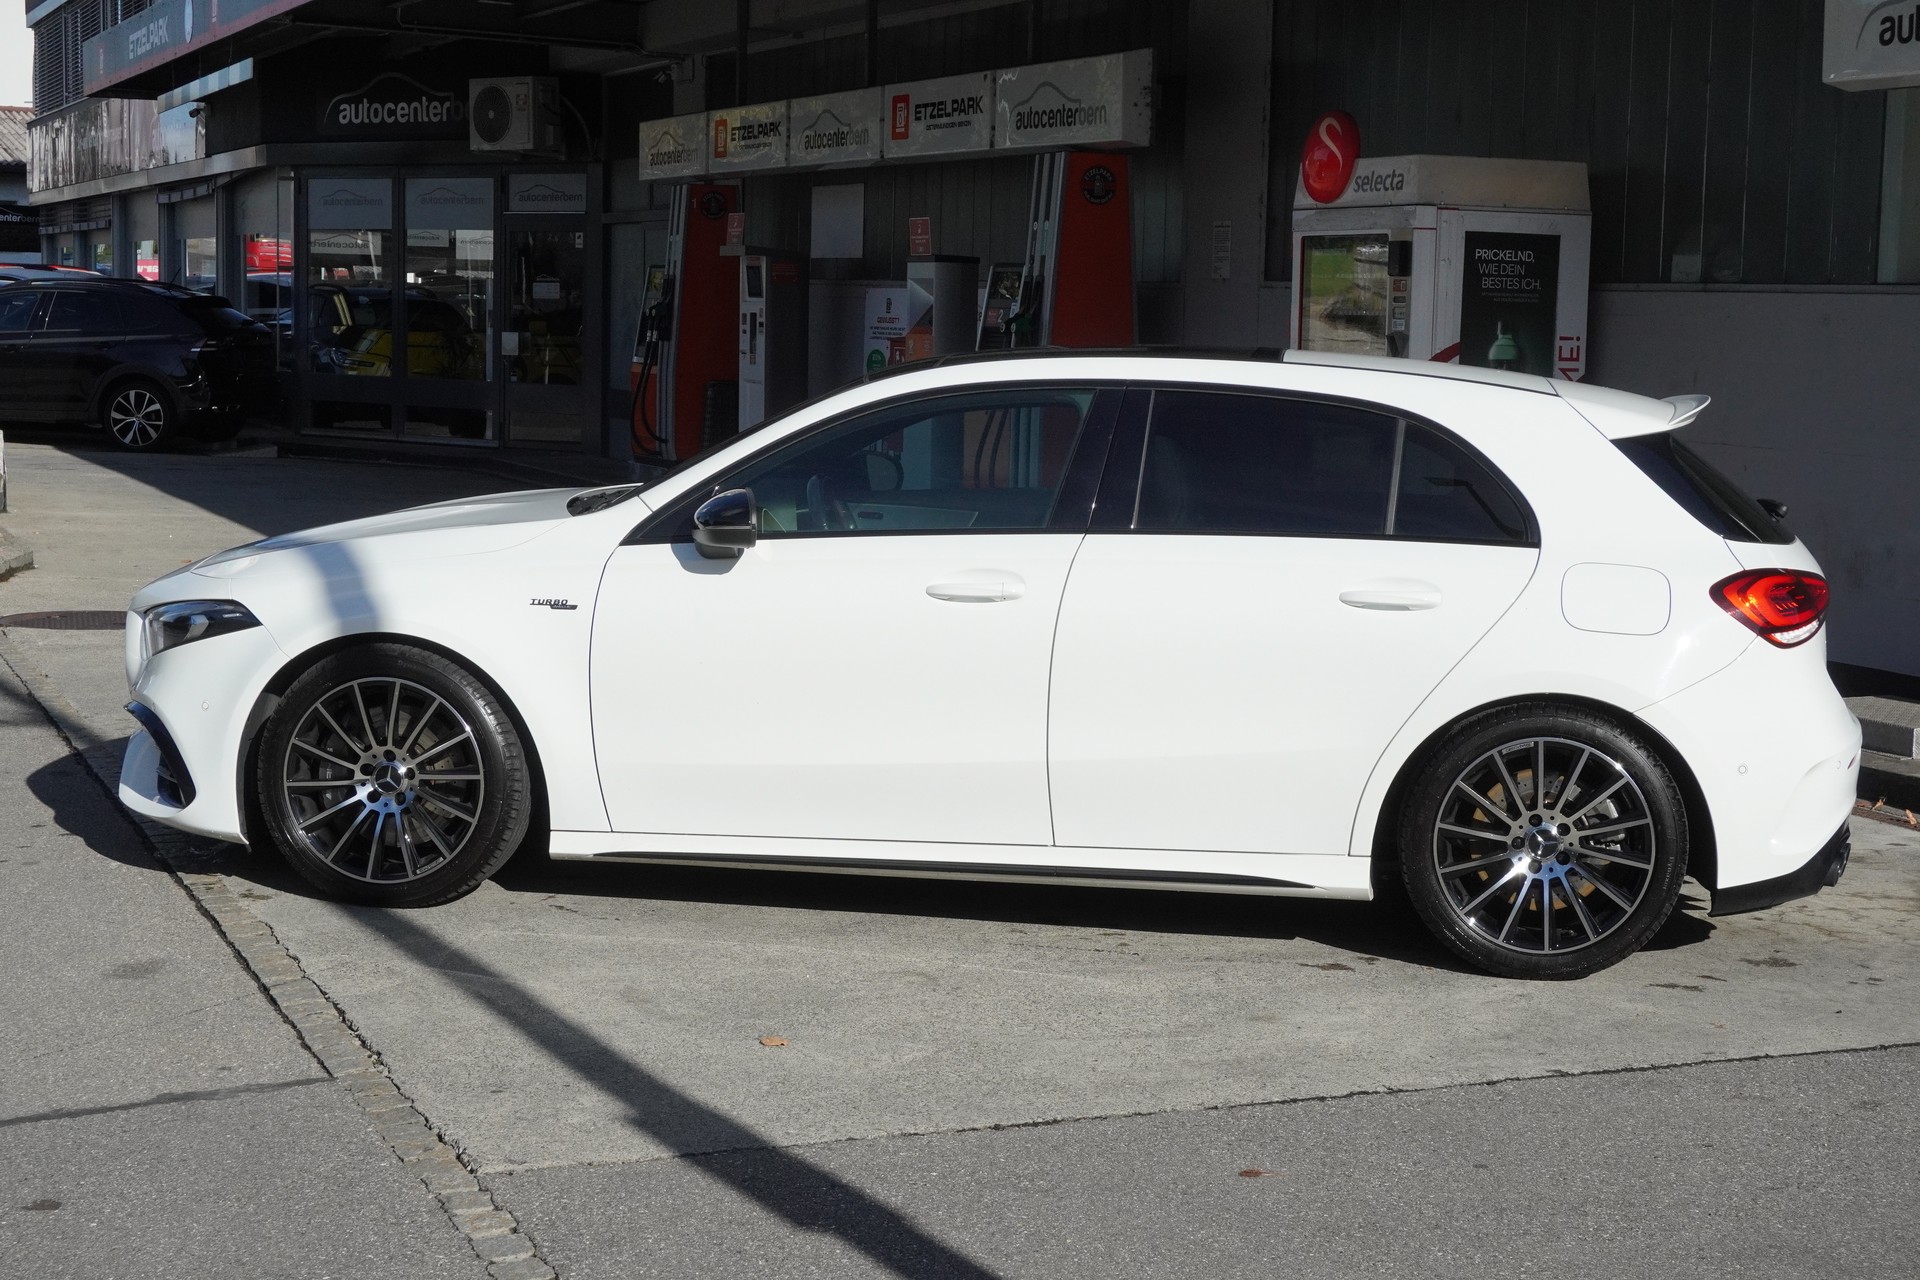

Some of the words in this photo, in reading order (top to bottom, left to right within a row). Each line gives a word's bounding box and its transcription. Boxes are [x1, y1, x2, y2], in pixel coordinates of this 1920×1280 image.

[129, 16, 169, 59] ETZELPARK
[914, 95, 984, 121] ETZELPARK
[1015, 103, 1107, 130] autocenterbern
[730, 121, 782, 142] ETZELPARK
[804, 127, 869, 150] autocenterbern
[1353, 169, 1405, 193] selecta
[518, 192, 583, 202] autocenterbern
[1475, 248, 1535, 263] PRICKELND,
[1478, 263, 1499, 275] WIE
[1500, 264, 1525, 275] DEIN
[1481, 277, 1520, 289] BESTES
[1521, 278, 1542, 290] ICH.
[529, 598, 568, 606] TURBO
